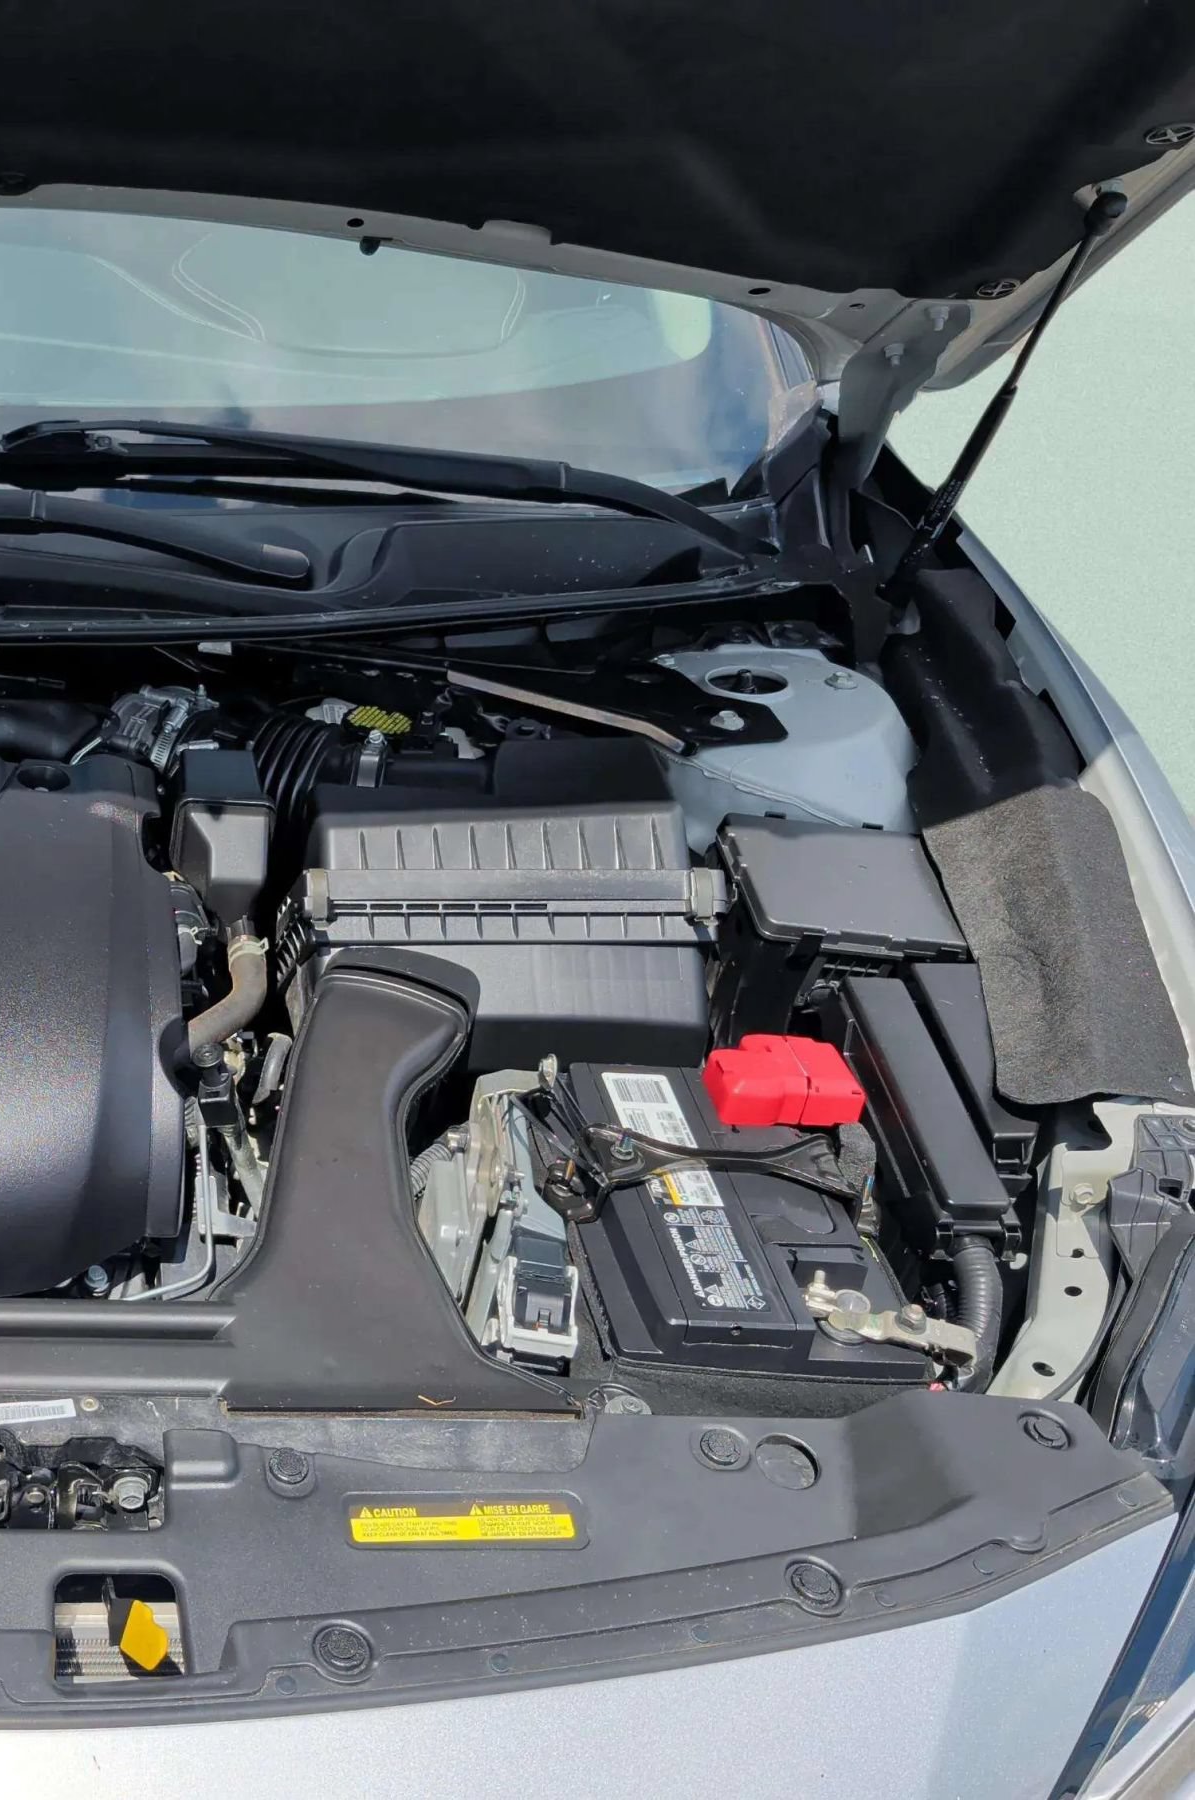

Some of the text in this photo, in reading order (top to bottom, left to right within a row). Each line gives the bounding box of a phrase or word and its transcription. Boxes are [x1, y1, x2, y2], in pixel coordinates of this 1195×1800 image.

[372, 1507, 418, 1518] CAUTION
[483, 1503, 552, 1516] MISE EN GARDE
